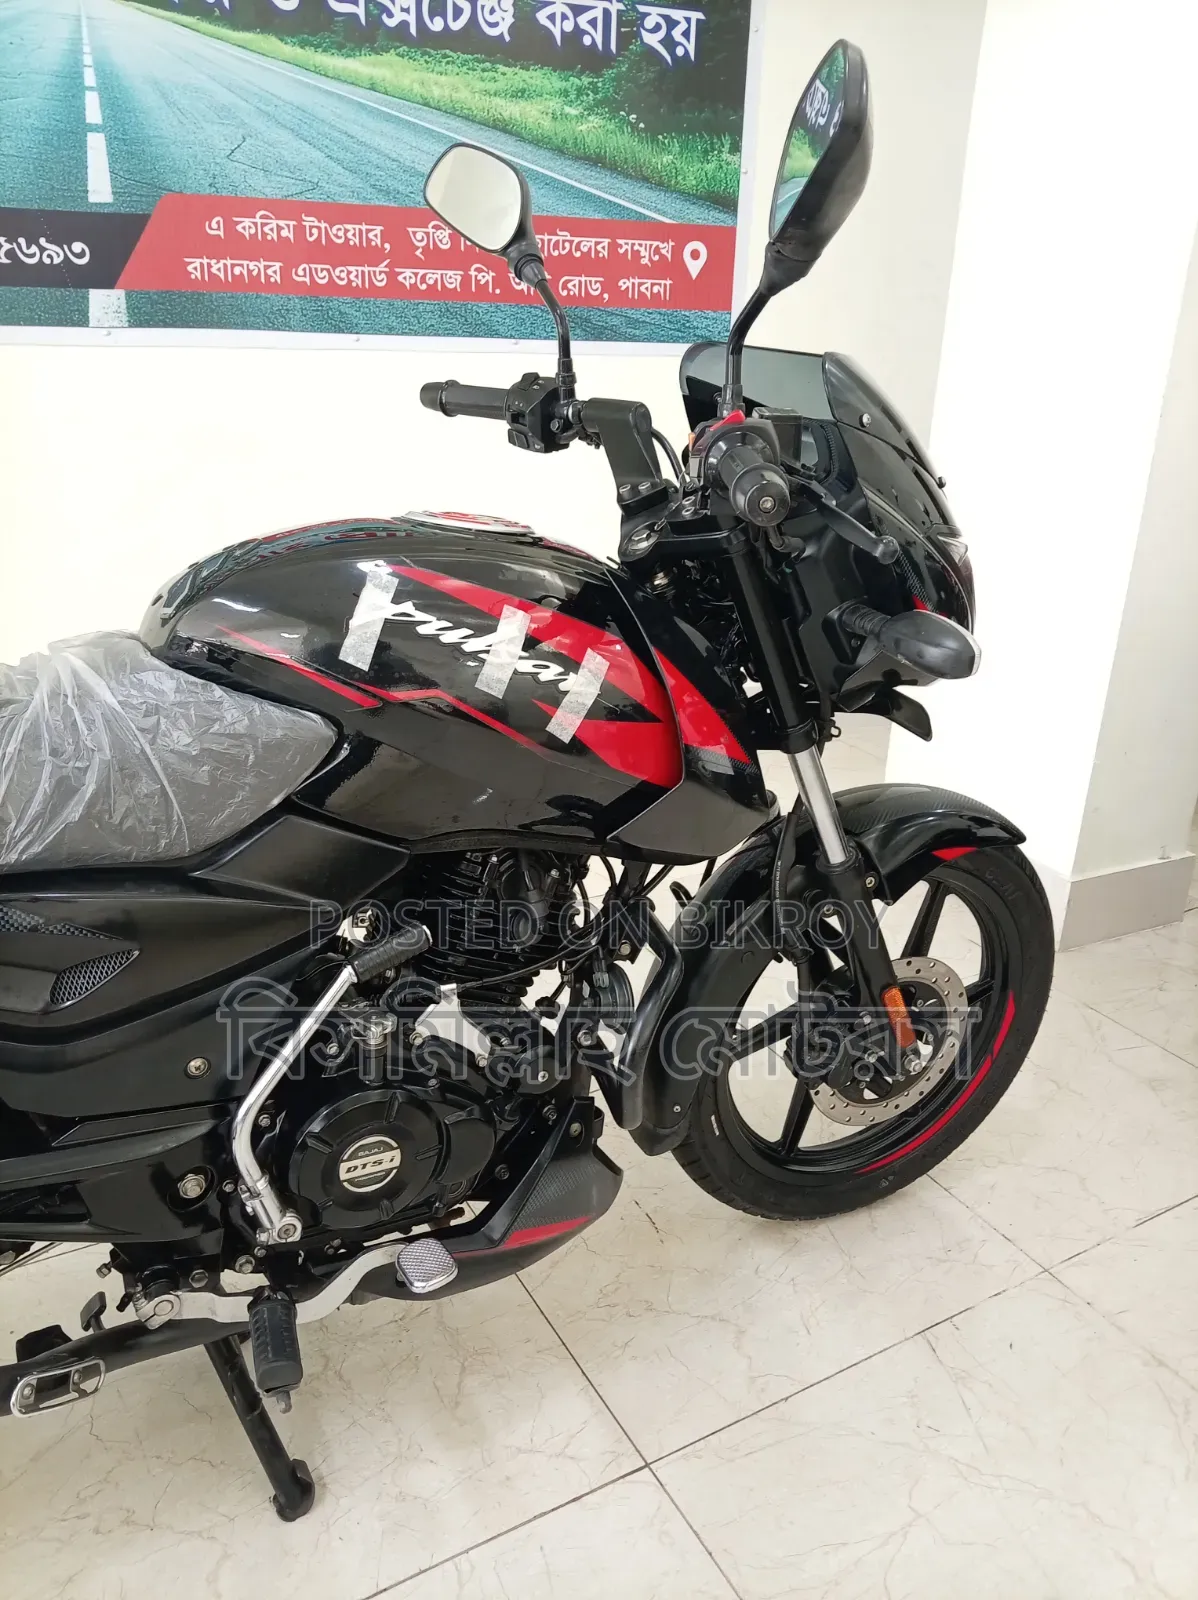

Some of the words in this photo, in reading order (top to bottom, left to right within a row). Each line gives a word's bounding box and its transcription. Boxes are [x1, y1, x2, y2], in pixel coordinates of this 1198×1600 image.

[535, 0, 625, 54] করা
[637, 4, 706, 66] হয়
[205, 216, 225, 240] এ
[232, 209, 298, 244] করিম
[301, 212, 391, 254] টাওয়ার,
[616, 237, 675, 269] সম্মুখে
[184, 255, 284, 285] রাধানগর
[292, 258, 392, 290] এডওয়ার্ড
[395, 267, 465, 292] কলেজ
[468, 263, 501, 294] পি.
[558, 274, 609, 303] রোড,
[617, 276, 673, 300] পাবনা
